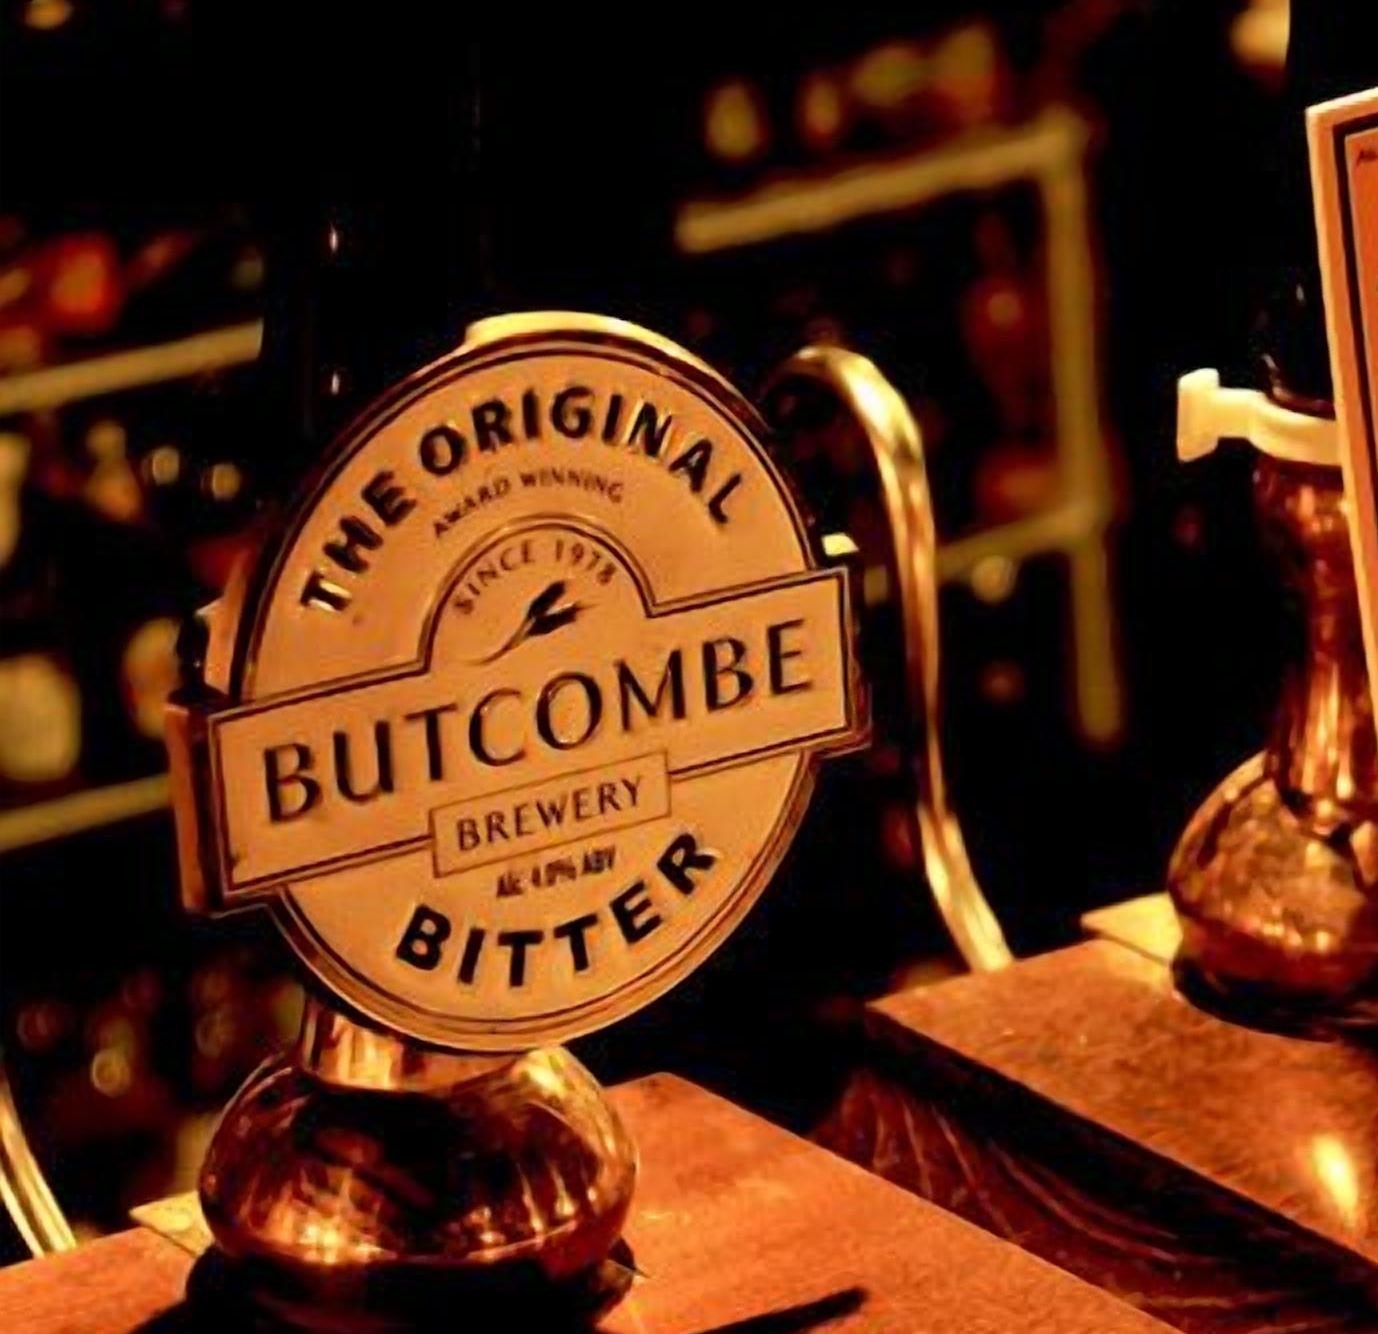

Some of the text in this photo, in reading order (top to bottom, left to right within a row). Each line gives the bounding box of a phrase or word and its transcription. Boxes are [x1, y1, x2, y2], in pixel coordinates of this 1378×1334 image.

[301, 385, 750, 615] THE ORIGINAL
[433, 467, 624, 540] AWARD WINNING
[453, 539, 617, 615] SINCE 1978
[262, 618, 814, 824] BUTCOMBE
[456, 774, 645, 852] BREWERY
[396, 829, 720, 988] BITTER
